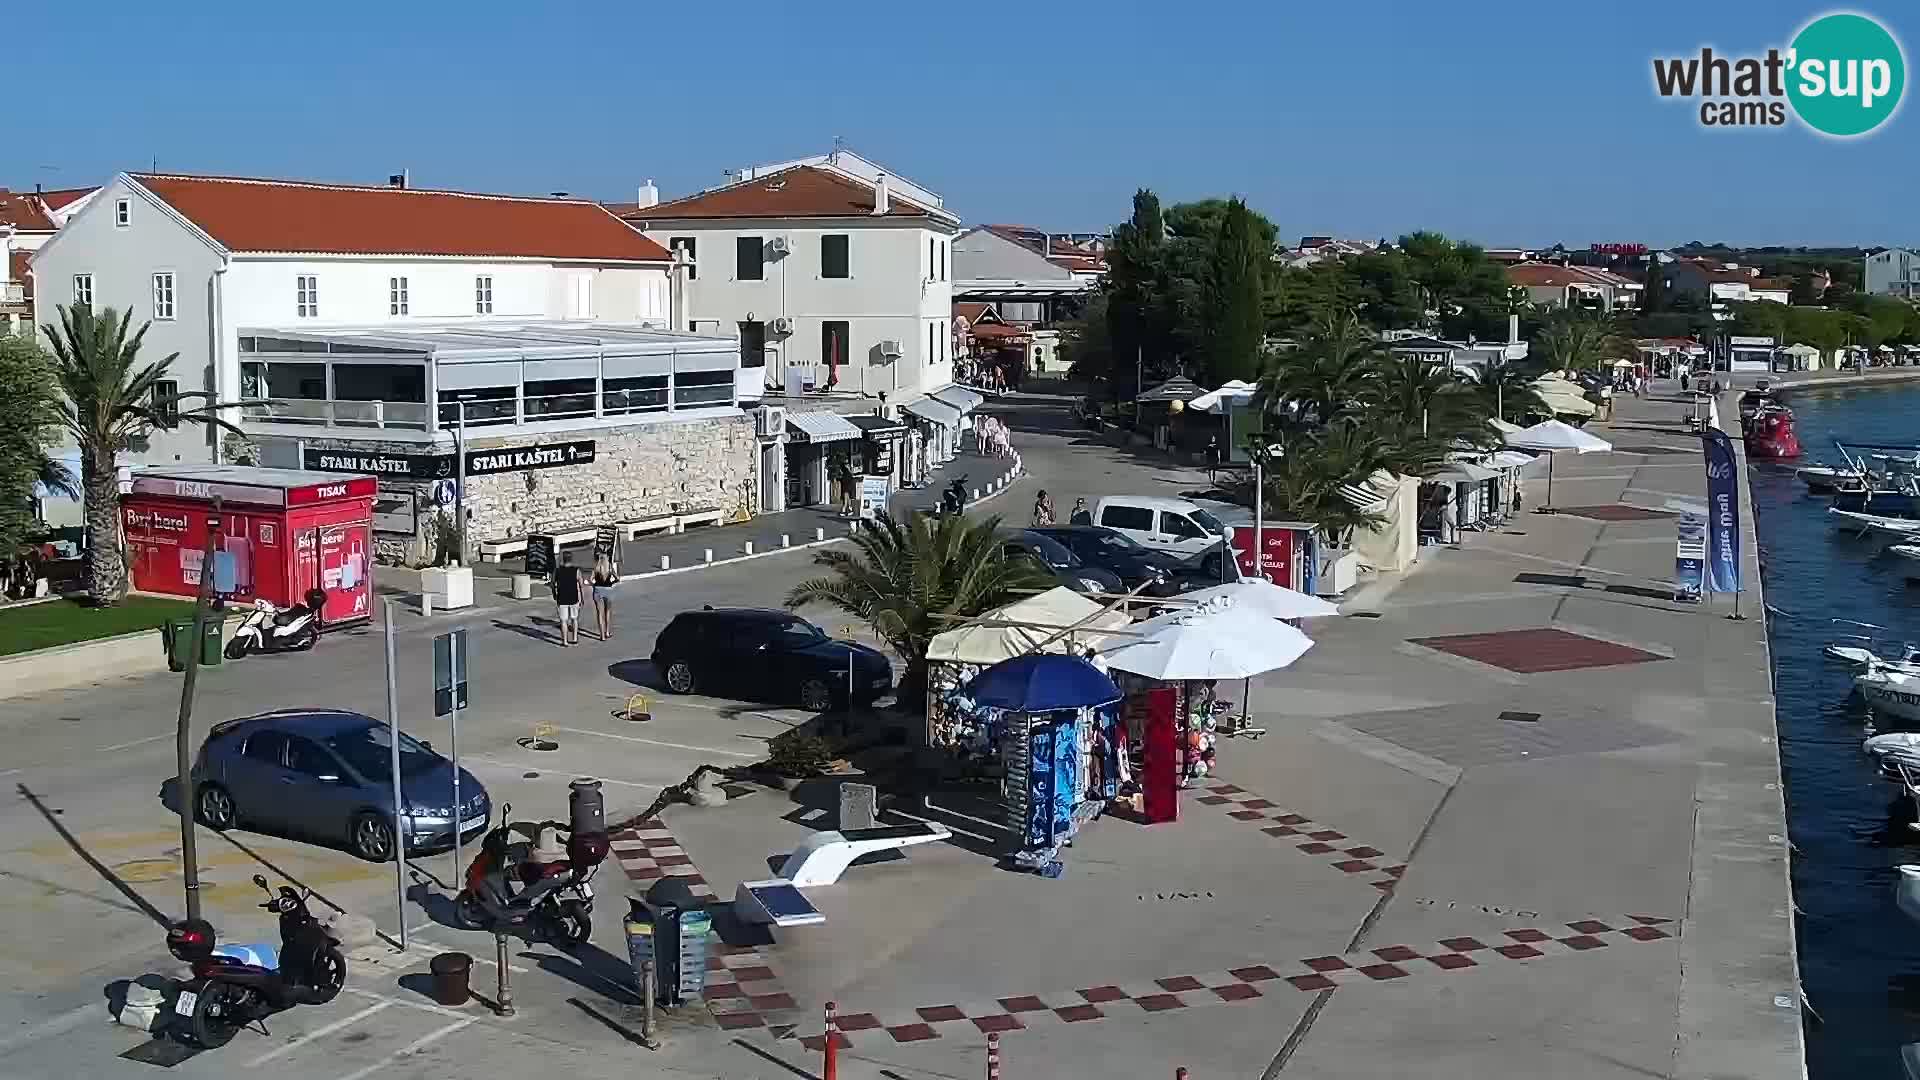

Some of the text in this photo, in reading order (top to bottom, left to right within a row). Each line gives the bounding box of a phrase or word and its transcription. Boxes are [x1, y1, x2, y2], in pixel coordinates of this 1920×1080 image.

[320, 455, 411, 473] STARI KAŠTEL
[473, 447, 565, 471] STARI KAŠTEL
[317, 485, 347, 499] TISAK
